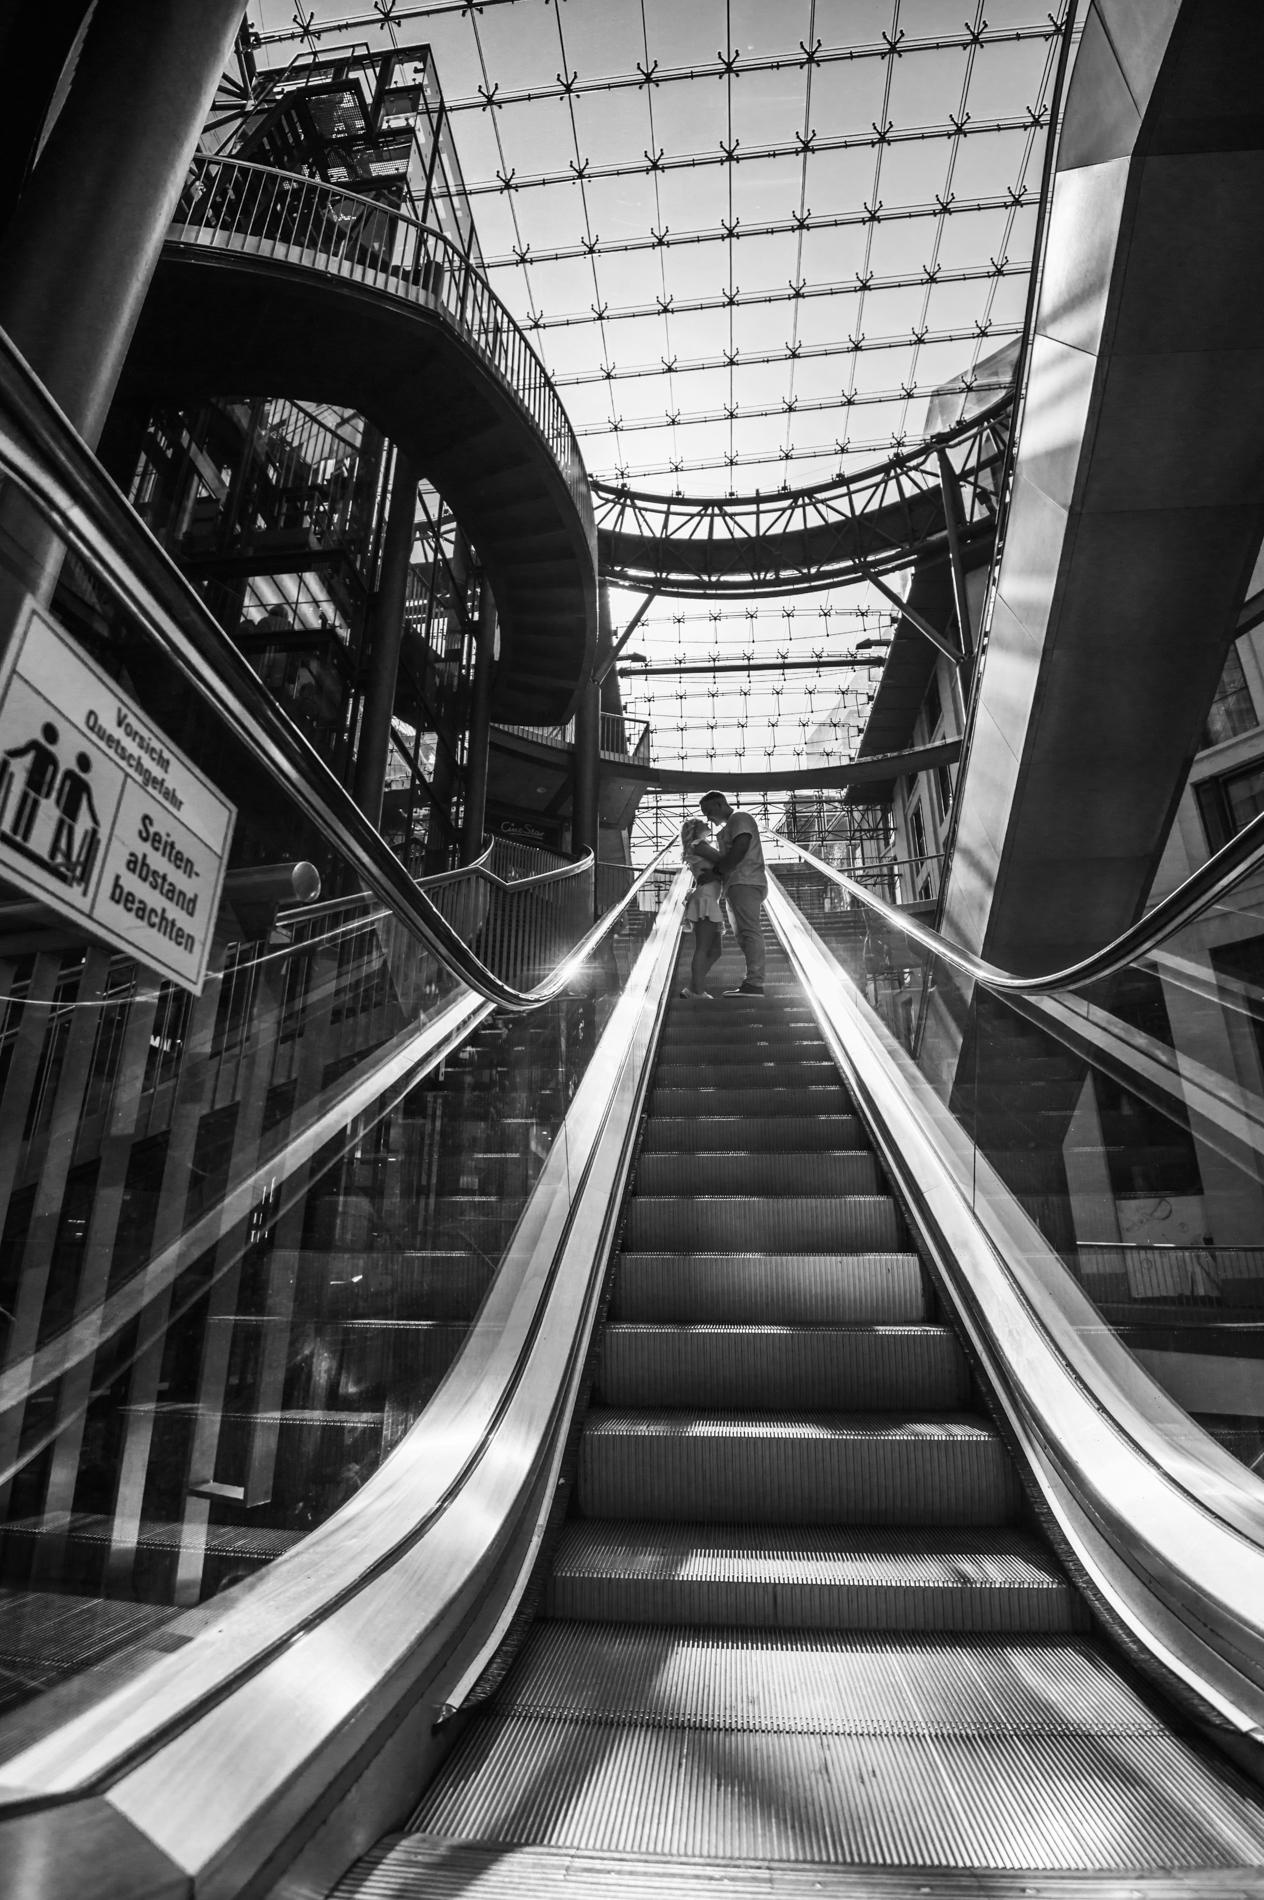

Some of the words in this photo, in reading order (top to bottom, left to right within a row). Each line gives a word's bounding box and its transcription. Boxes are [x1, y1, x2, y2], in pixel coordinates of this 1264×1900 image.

[85, 709, 184, 811] Quetschgefahr
[116, 706, 171, 774] Vorsicht
[138, 813, 200, 879] Seiten-
[109, 873, 196, 954] beachten
[125, 851, 199, 918] abstand
